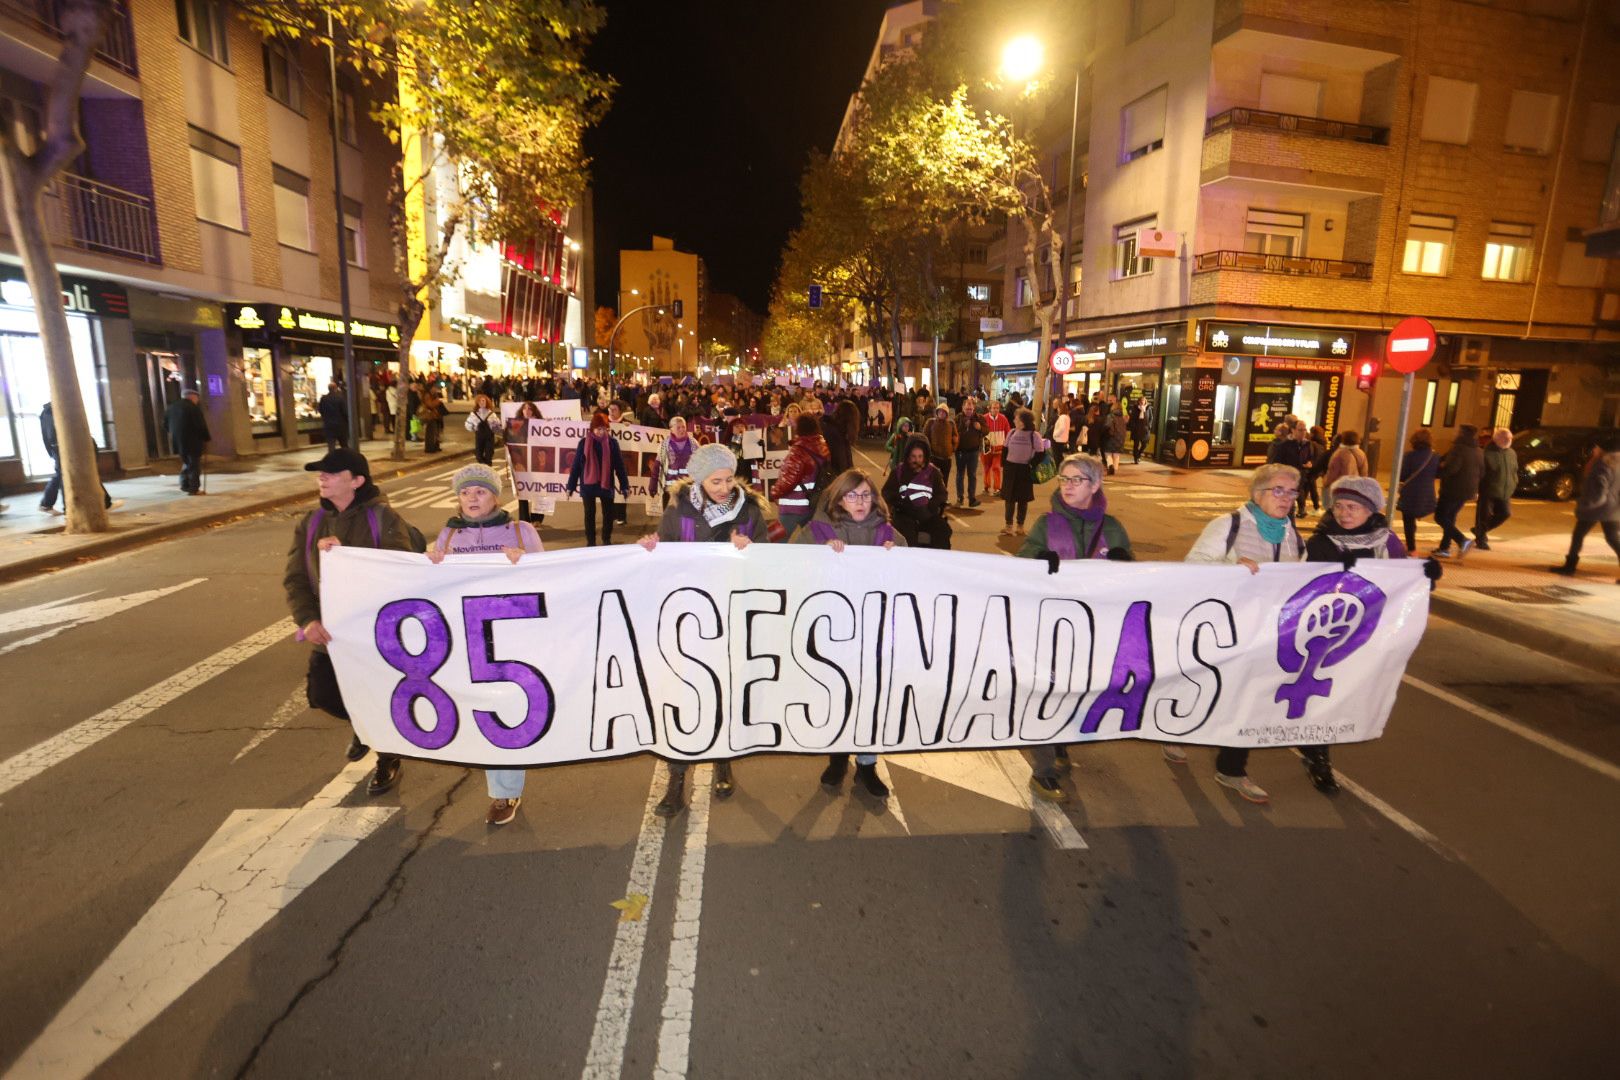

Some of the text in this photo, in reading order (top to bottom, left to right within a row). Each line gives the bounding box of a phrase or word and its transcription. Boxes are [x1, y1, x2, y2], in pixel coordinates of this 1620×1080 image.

[1055, 356, 1070, 366] 30
[1324, 376, 1340, 450] PRAMOS ORO
[531, 426, 561, 438] NOS
[565, 427, 641, 442] QUMOS
[757, 459, 782, 470] REC
[374, 586, 1239, 756] 85 ASESINADAS
[1304, 723, 1356, 736] FEMINISTA
[1256, 733, 1337, 745] DE SALAMANCA
